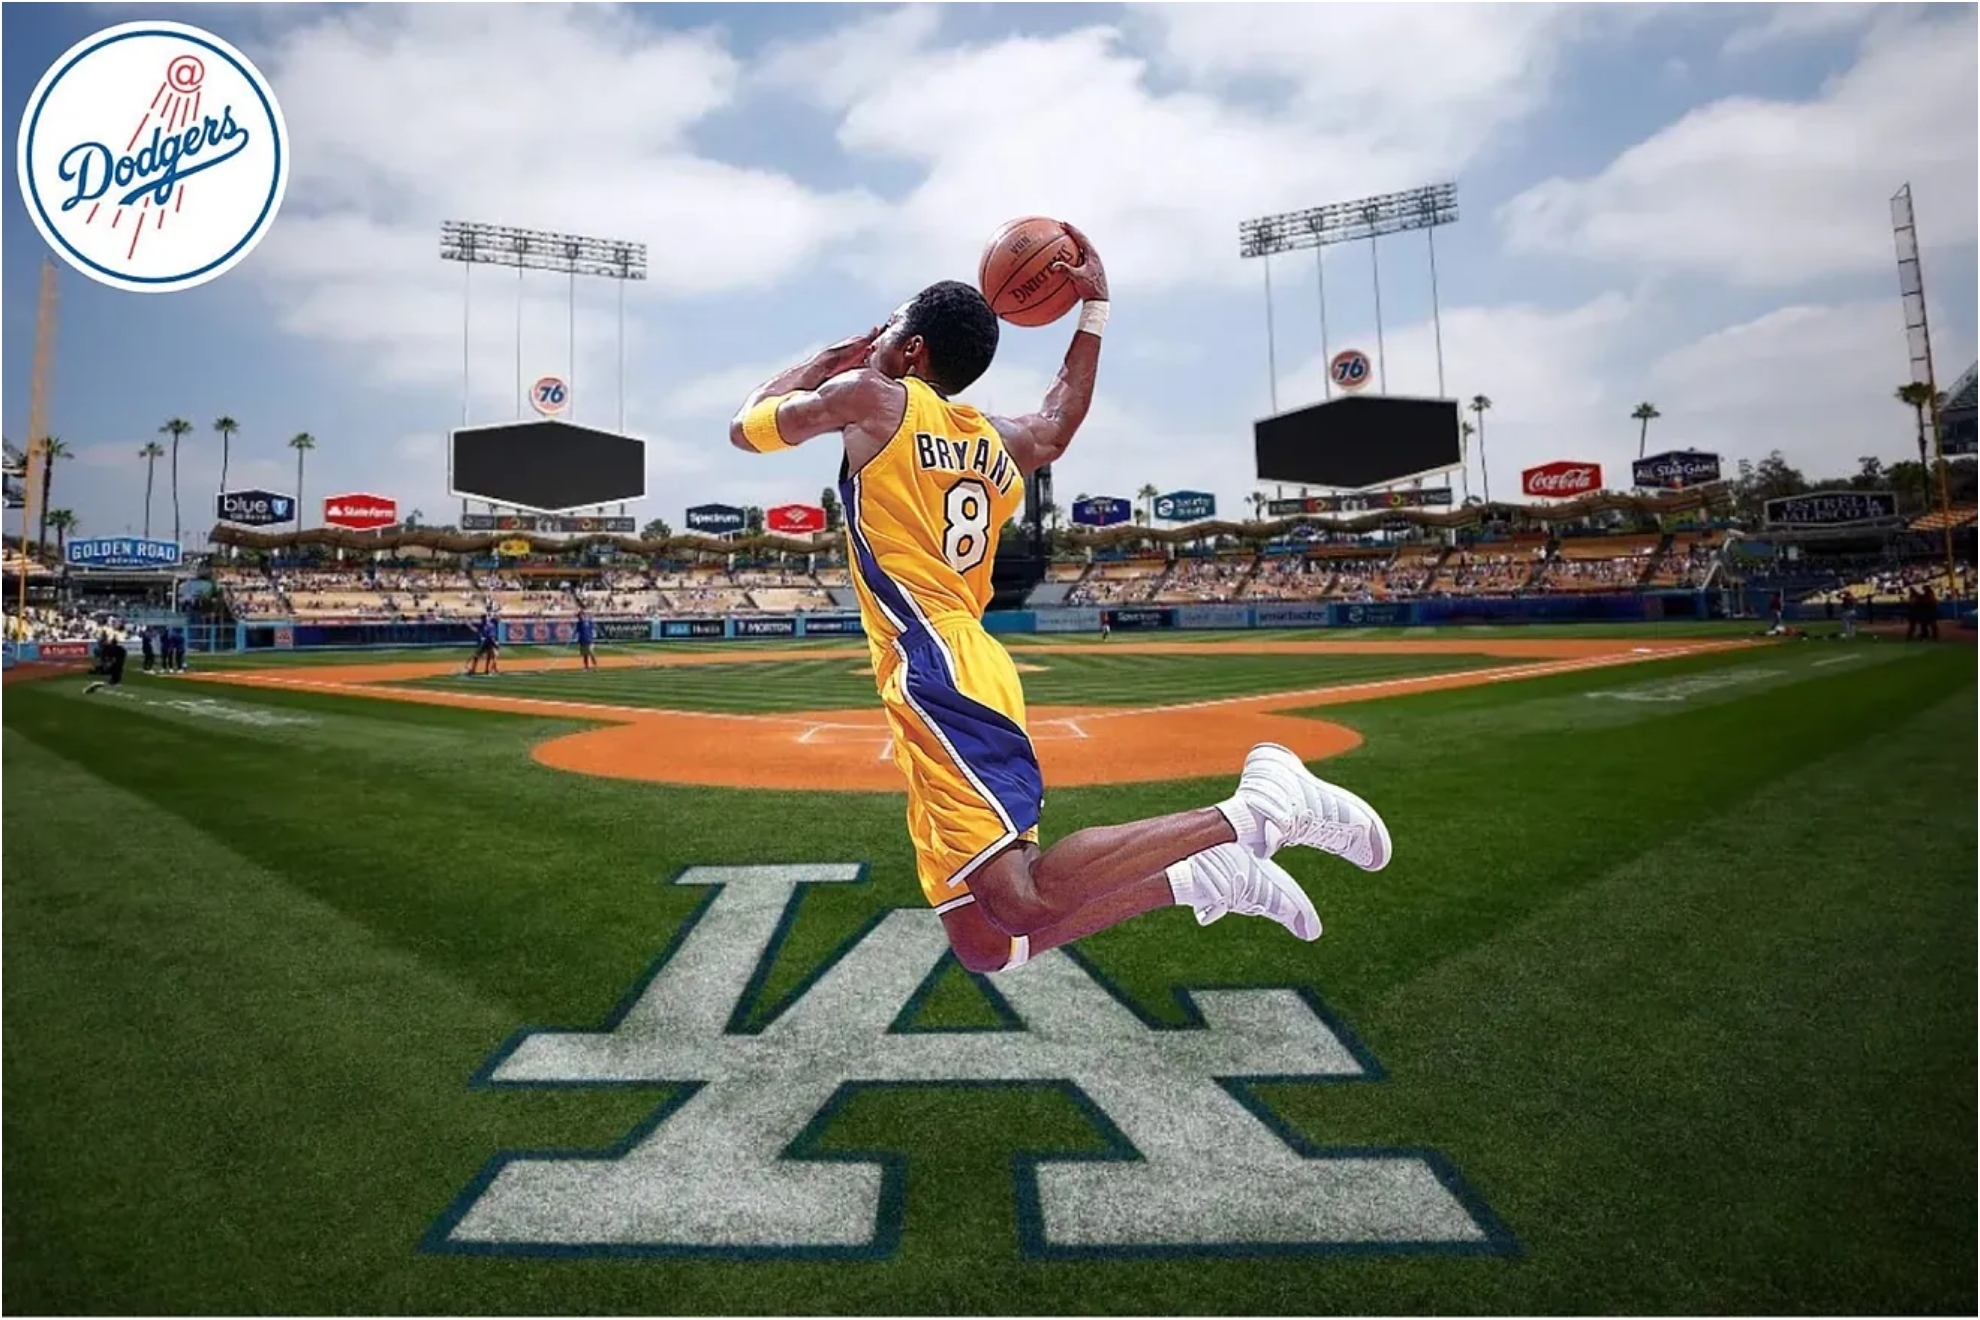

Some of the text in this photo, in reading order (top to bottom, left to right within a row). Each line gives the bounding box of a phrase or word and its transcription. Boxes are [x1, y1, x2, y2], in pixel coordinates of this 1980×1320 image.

[1338, 357, 1363, 380] 76
[540, 385, 564, 403] 76
[916, 433, 1016, 496] BRYANT
[224, 494, 269, 513] blue
[690, 512, 740, 525] Spectrum
[943, 477, 990, 574] 8
[72, 541, 175, 561] GOLDEN ROAD
[428, 861, 1508, 1254] LA
